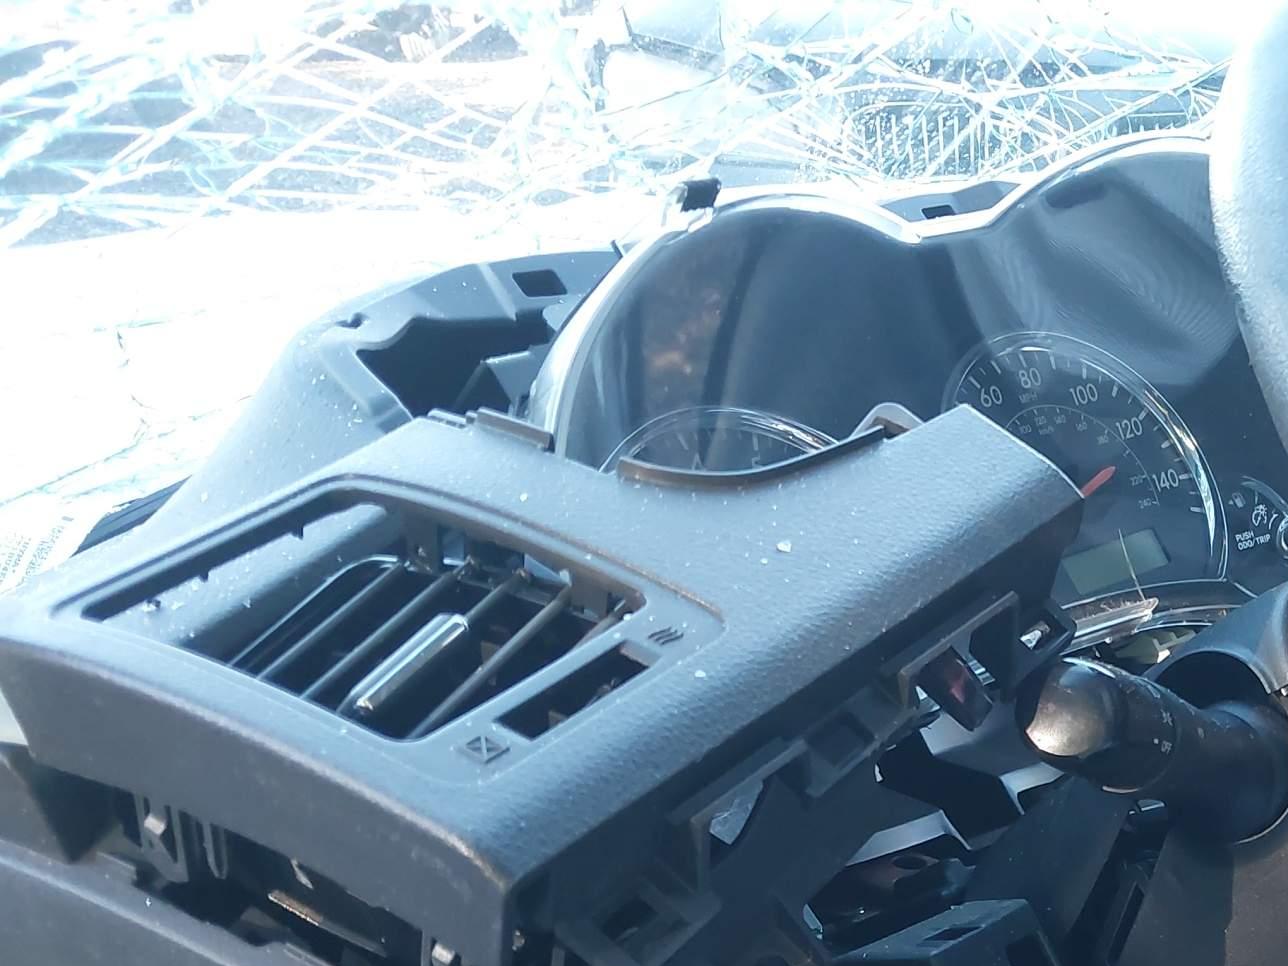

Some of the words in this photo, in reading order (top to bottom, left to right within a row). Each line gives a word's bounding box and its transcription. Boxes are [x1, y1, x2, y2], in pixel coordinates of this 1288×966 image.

[1018, 366, 1042, 389] 80
[979, 386, 1003, 408] 60
[1069, 383, 1099, 407] 100
[1115, 416, 1143, 441] 120
[1152, 468, 1180, 492] 140
[1234, 530, 1255, 543] PUSH
[1237, 533, 1272, 551] ODO/TRIP
